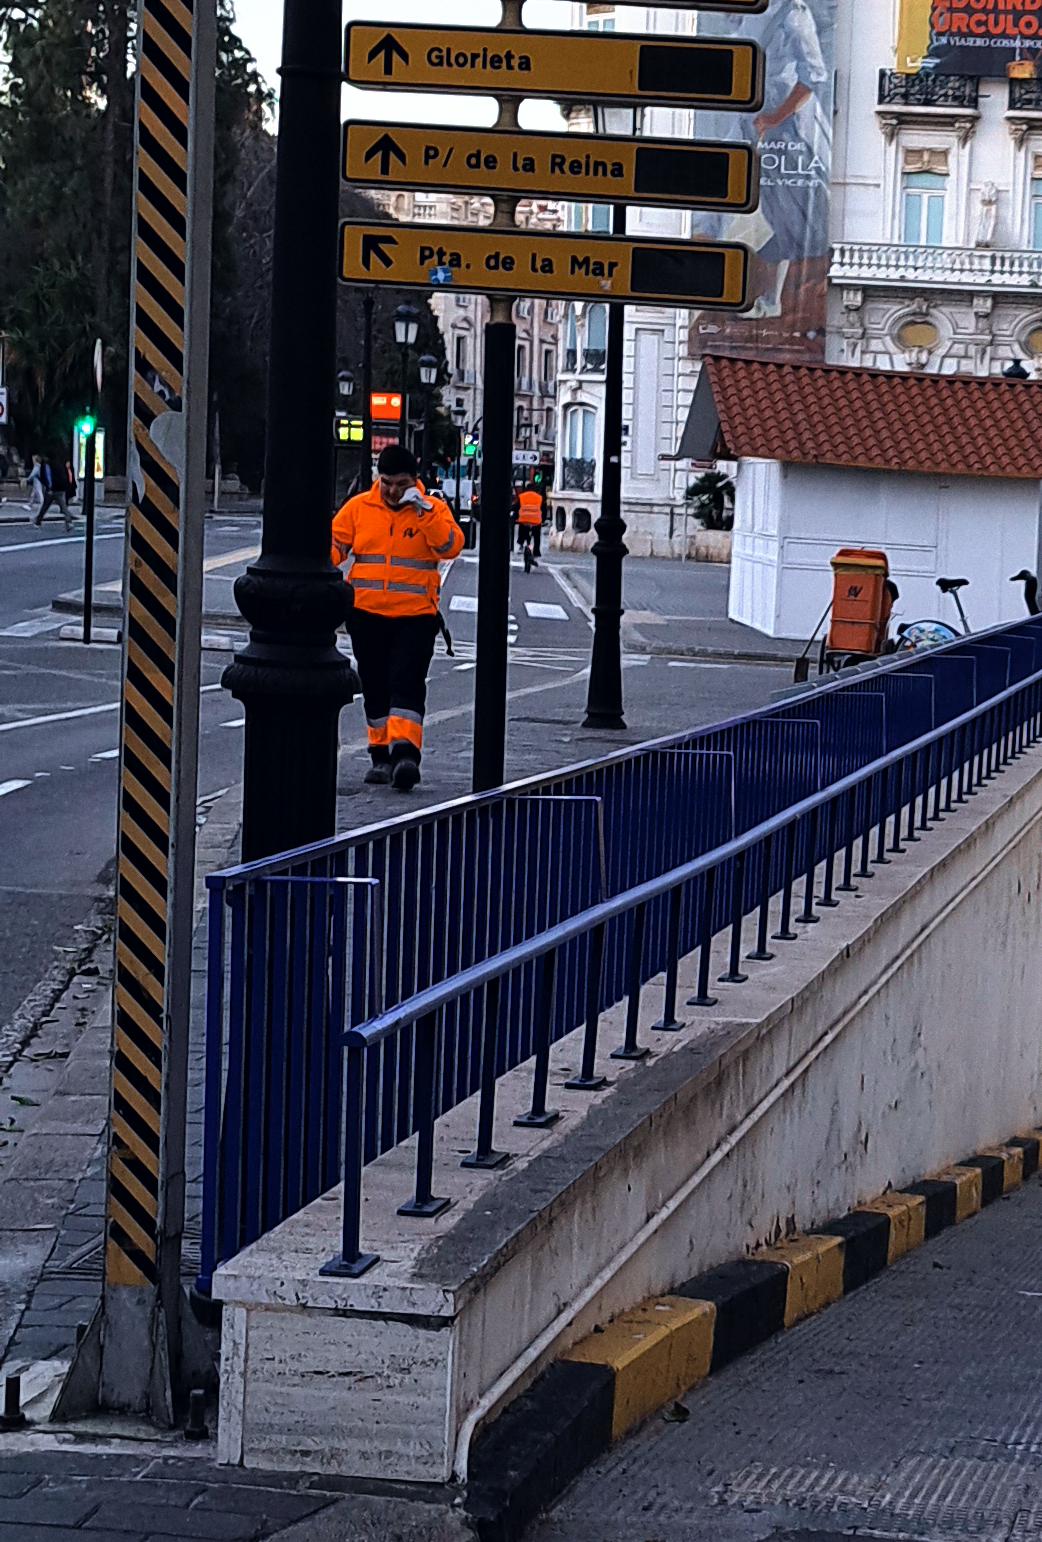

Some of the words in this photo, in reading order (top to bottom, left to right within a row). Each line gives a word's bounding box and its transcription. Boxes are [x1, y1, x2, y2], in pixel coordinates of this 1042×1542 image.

[949, 36, 990, 47] VIAJERO
[426, 46, 532, 72] Glorieta
[757, 141, 786, 151] MAR
[423, 144, 455, 168] P/
[466, 149, 498, 170] de
[512, 151, 536, 174] la
[550, 153, 625, 178] Reina
[761, 153, 826, 174] OLLA
[418, 245, 471, 269] Pta.
[485, 251, 515, 271] de
[530, 252, 554, 274] la
[569, 255, 619, 278] Mar
